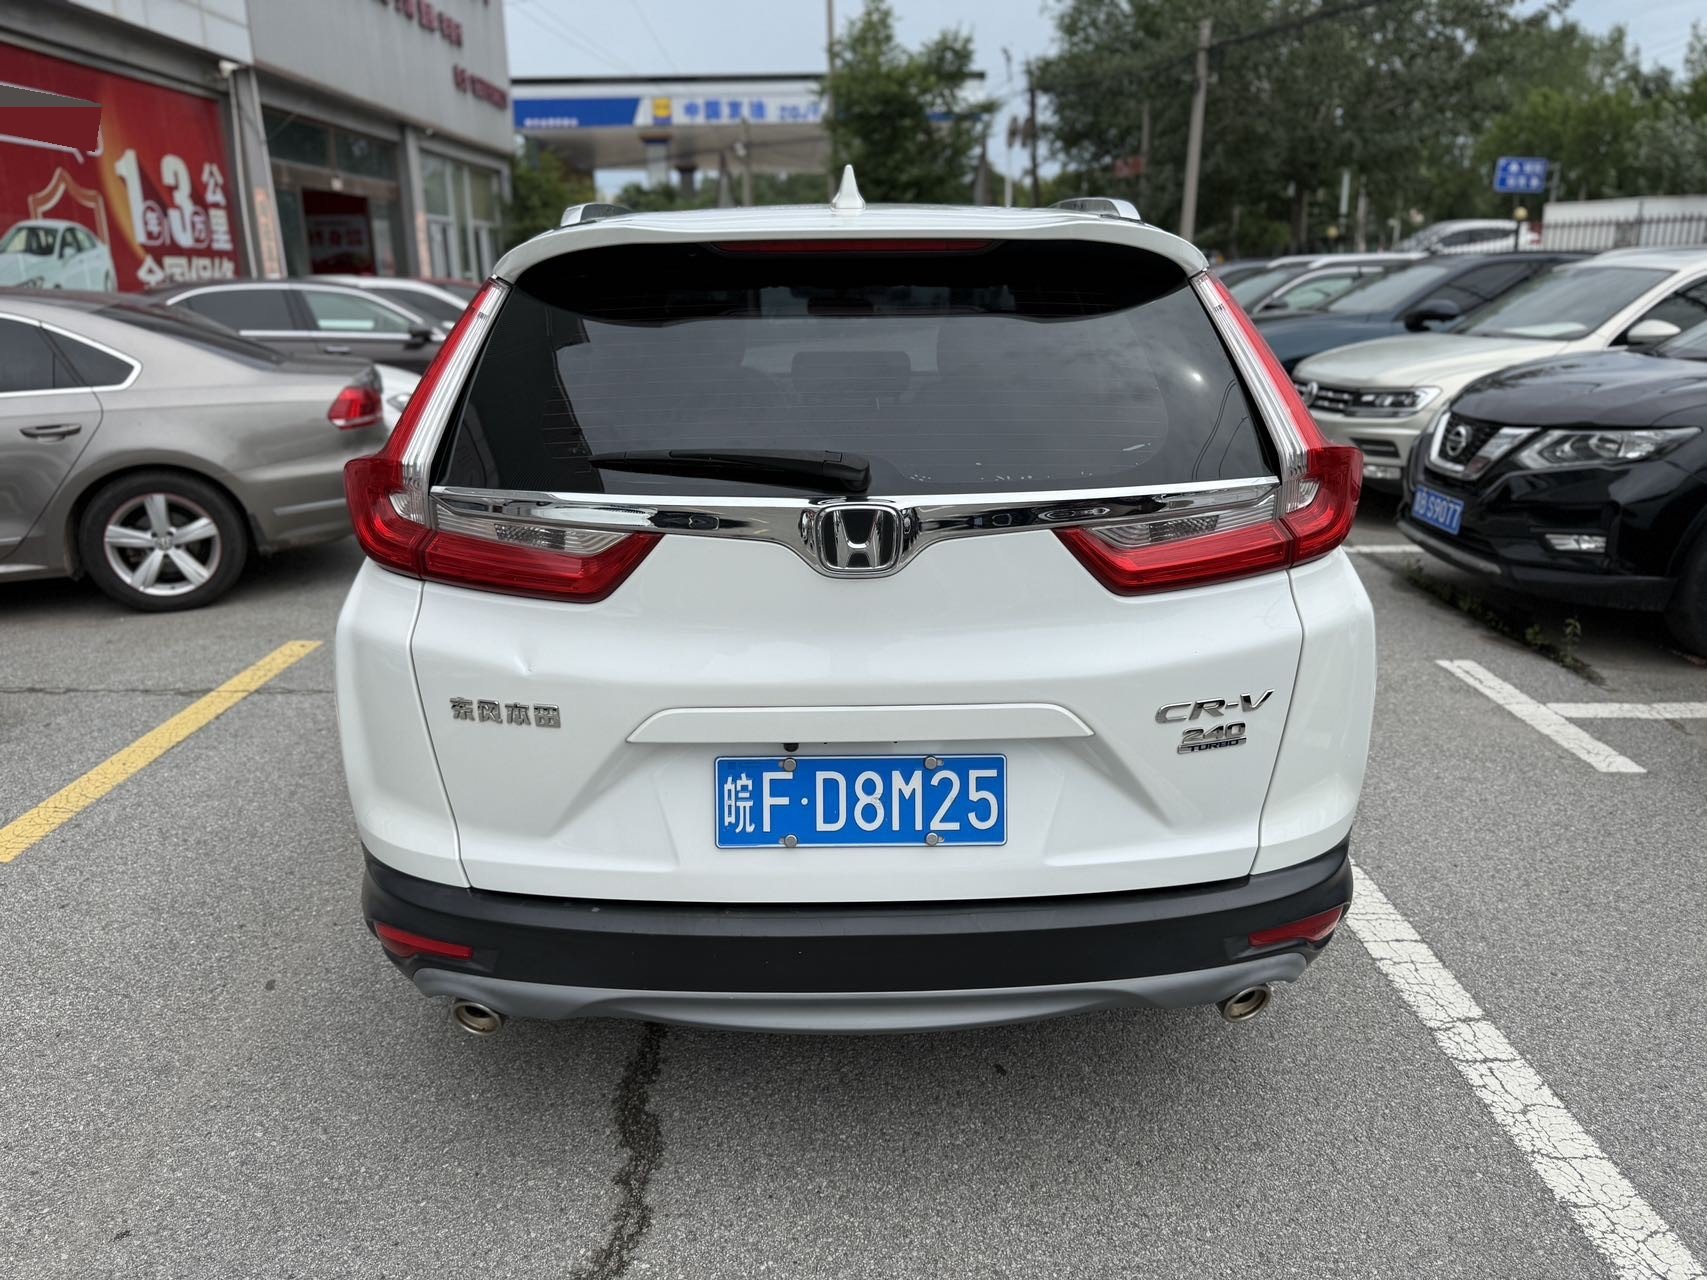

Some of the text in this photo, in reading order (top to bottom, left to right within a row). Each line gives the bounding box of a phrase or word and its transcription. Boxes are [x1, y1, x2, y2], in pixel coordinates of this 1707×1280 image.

[449, 697, 561, 728] 东风本田
[1155, 689, 1275, 724] CR-V
[1181, 722, 1246, 744] 240
[1182, 738, 1246, 753] TURBO
